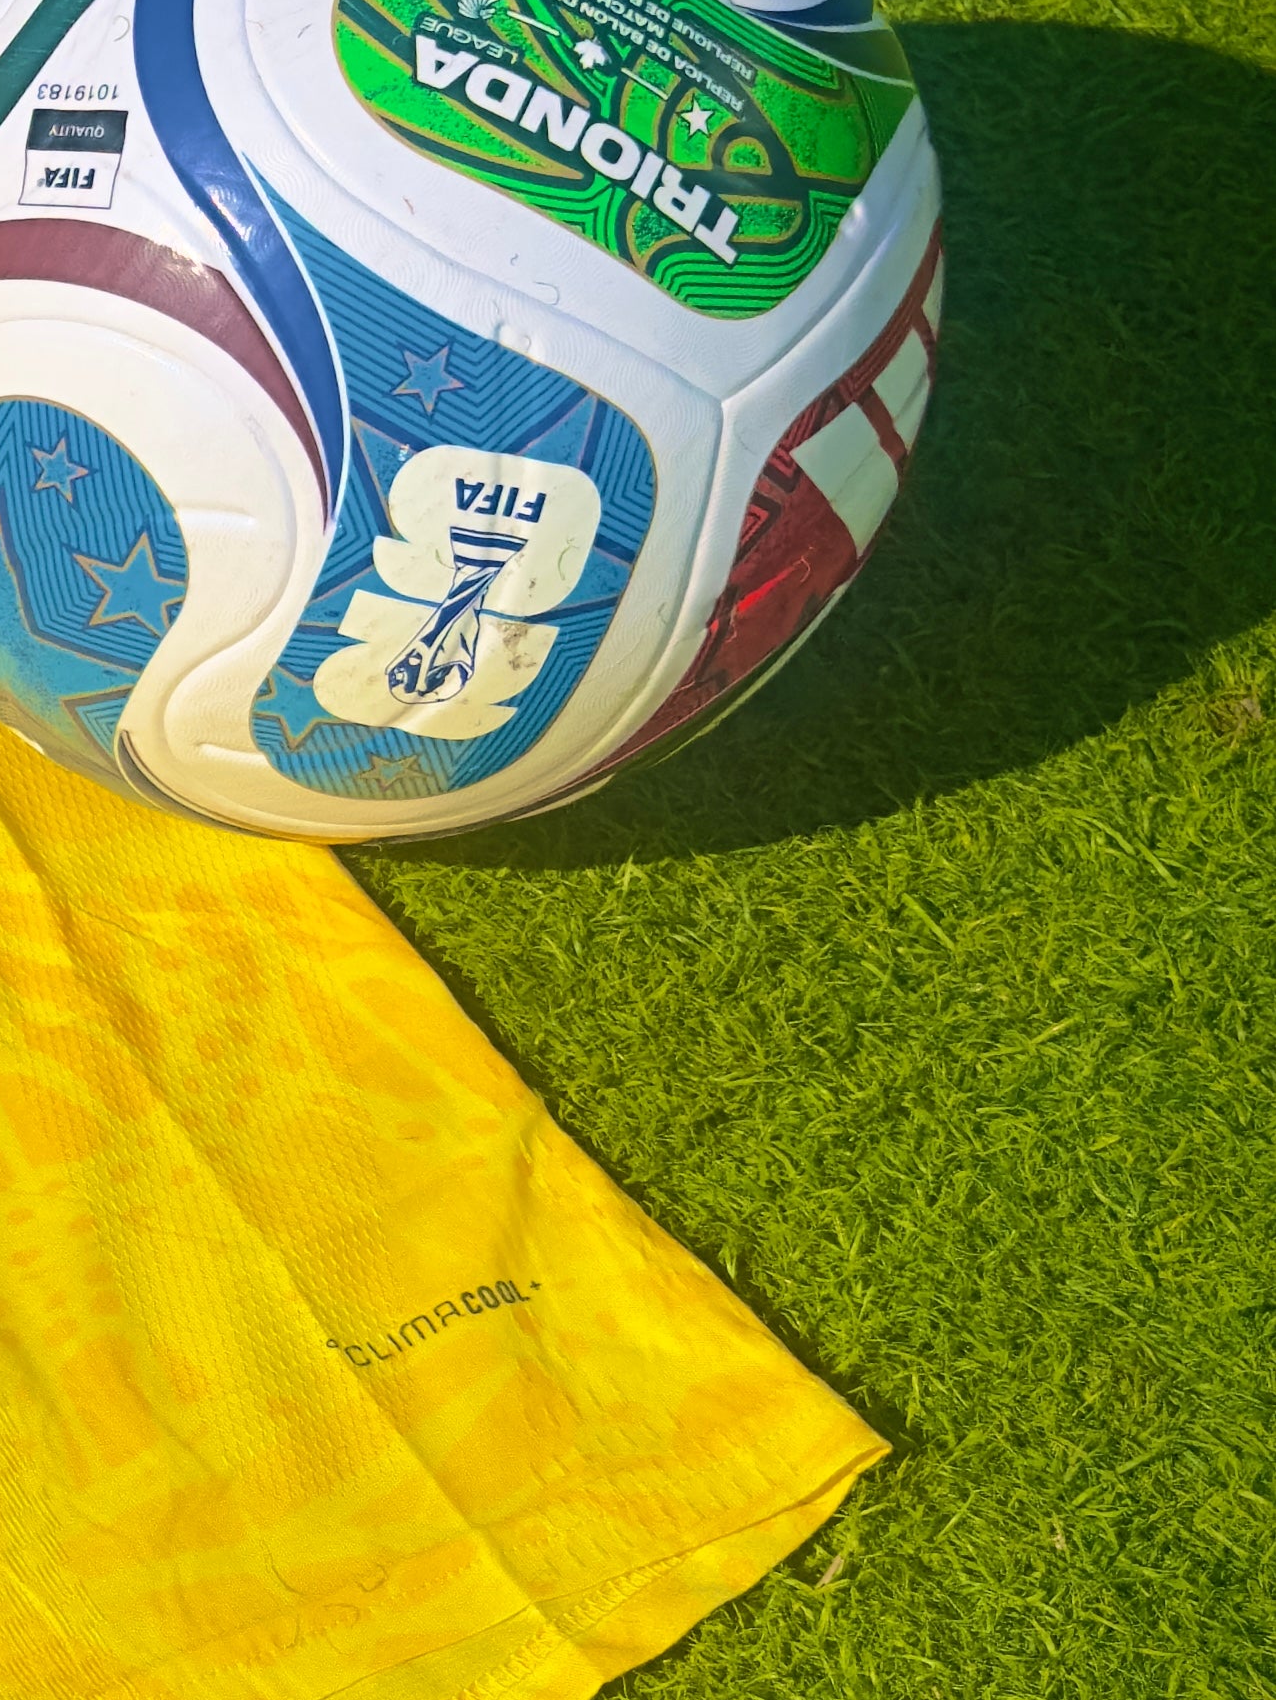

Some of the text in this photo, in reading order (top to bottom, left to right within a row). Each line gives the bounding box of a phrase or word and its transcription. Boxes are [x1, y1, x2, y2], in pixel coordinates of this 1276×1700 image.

[579, 4, 644, 44] BALÓN
[645, 0, 671, 21] DE
[420, 16, 519, 64] LEAGUE
[646, 38, 675, 60] DE
[37, 83, 120, 101] 1019183
[49, 124, 105, 138] QUALITY
[415, 34, 740, 265] TRIONDA
[454, 477, 547, 524] FIFA
